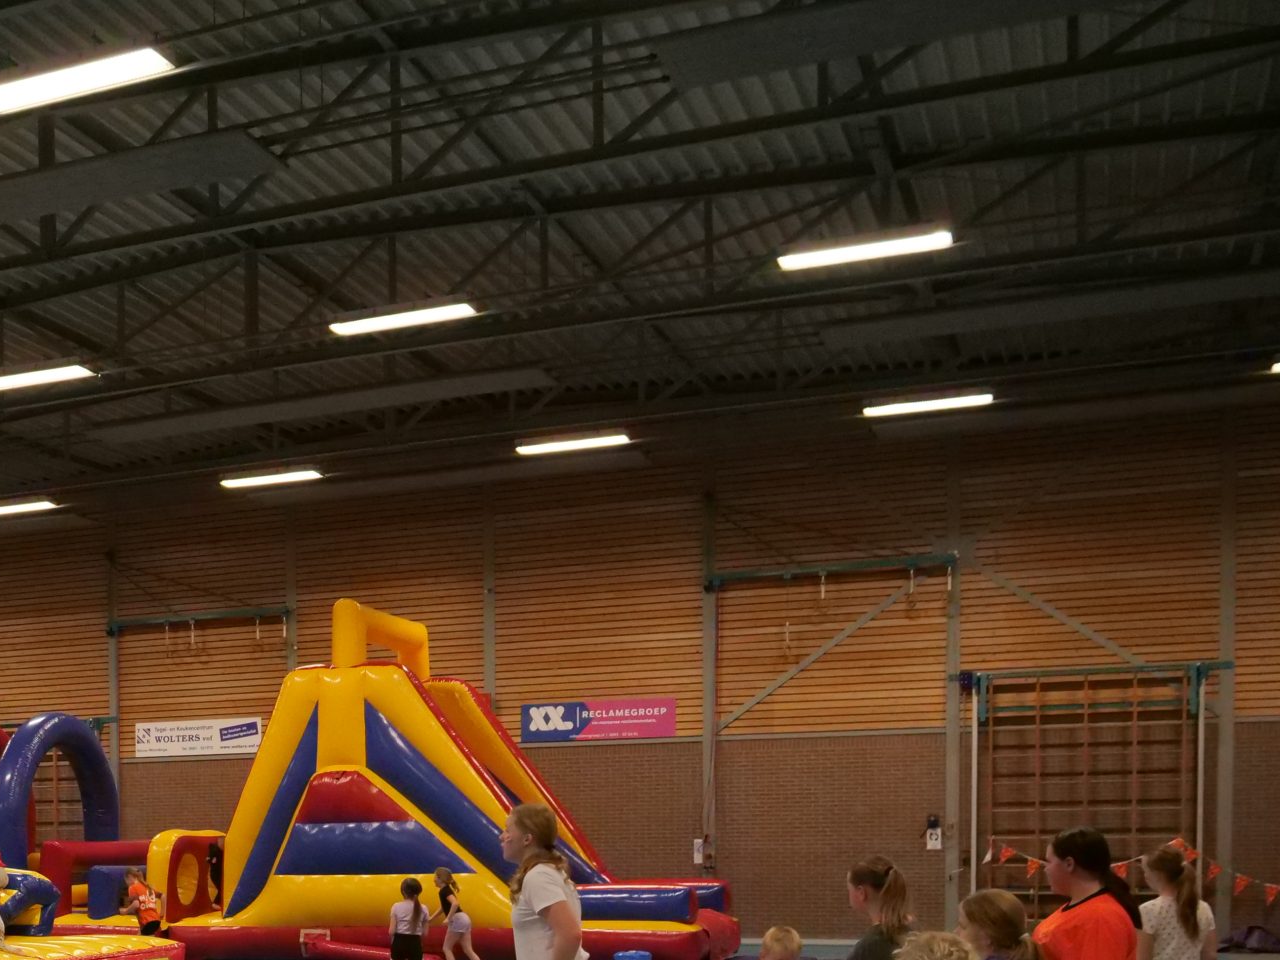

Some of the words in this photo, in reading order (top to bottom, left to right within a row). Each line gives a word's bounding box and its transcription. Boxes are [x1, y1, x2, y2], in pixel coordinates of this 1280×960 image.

[529, 705, 574, 732] XXL
[581, 707, 667, 718] RECLAMEGROEP
[154, 733, 201, 744] WOLTERS
